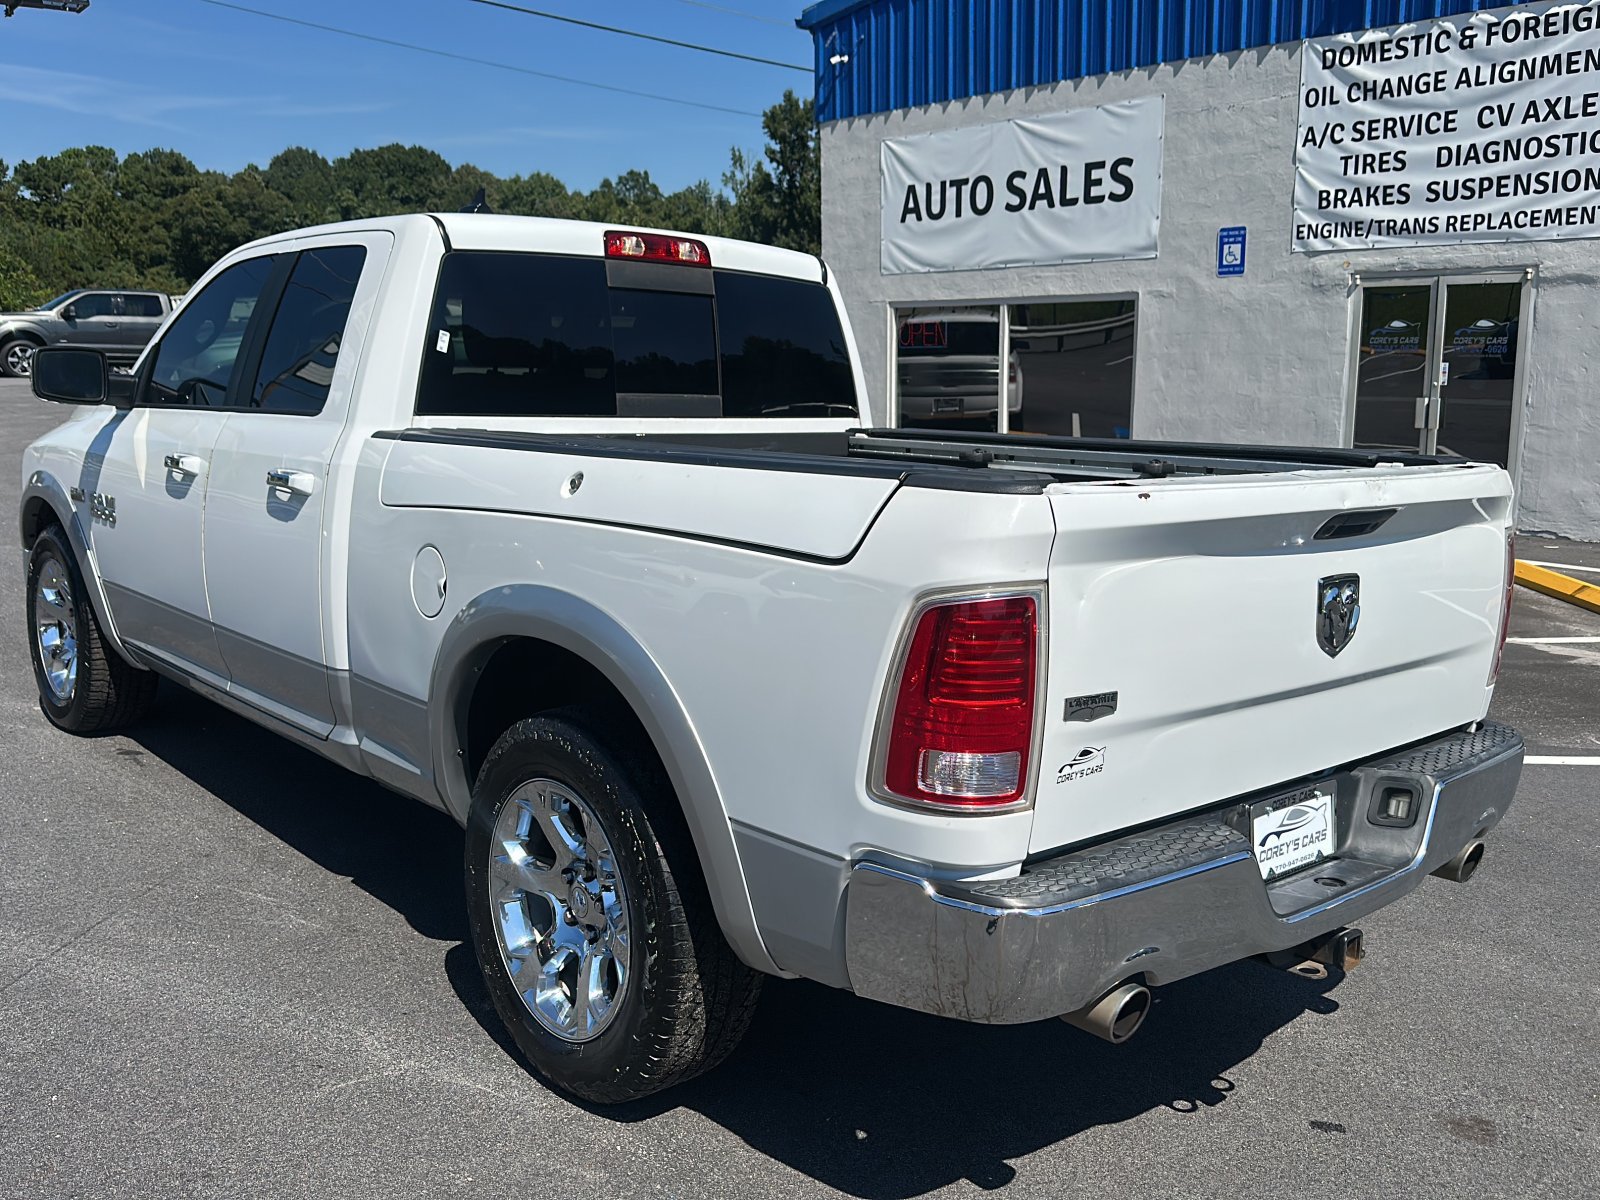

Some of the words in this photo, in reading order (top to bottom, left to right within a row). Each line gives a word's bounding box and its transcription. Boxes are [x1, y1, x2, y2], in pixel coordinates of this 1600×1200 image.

[1321, 29, 1450, 70] DOMESTIC
[1459, 26, 1478, 50] &
[1486, 5, 1600, 46] FOREIG
[1305, 85, 1340, 108] OIL
[1347, 70, 1447, 103] CHANGE
[1455, 48, 1600, 90] ALIGNMEN
[1302, 122, 1345, 149] A/C
[1350, 109, 1458, 142] SERVICE
[1477, 102, 1515, 129] CV
[1521, 92, 1599, 125] AXLE
[1340, 150, 1407, 176] TIRES
[900, 174, 994, 223] AUTO
[1004, 157, 1134, 213] SALES
[1318, 183, 1411, 210] BRAKES
[1425, 167, 1600, 203] SUSPENSION
[1296, 216, 1439, 241] ENGINE/TRANS
[1445, 205, 1600, 233] REPLACEMEN
[900, 320, 947, 347] OPEN
[1399, 336, 1419, 344] CARS
[1453, 336, 1486, 345] COREY'S
[1486, 336, 1509, 345] CARS
[1068, 692, 1116, 708] LARAMIE
[1056, 769, 1085, 784] COREY'S
[1085, 764, 1104, 777] CARS
[1259, 838, 1300, 863] COREY'S
[1301, 829, 1327, 848] CARS
